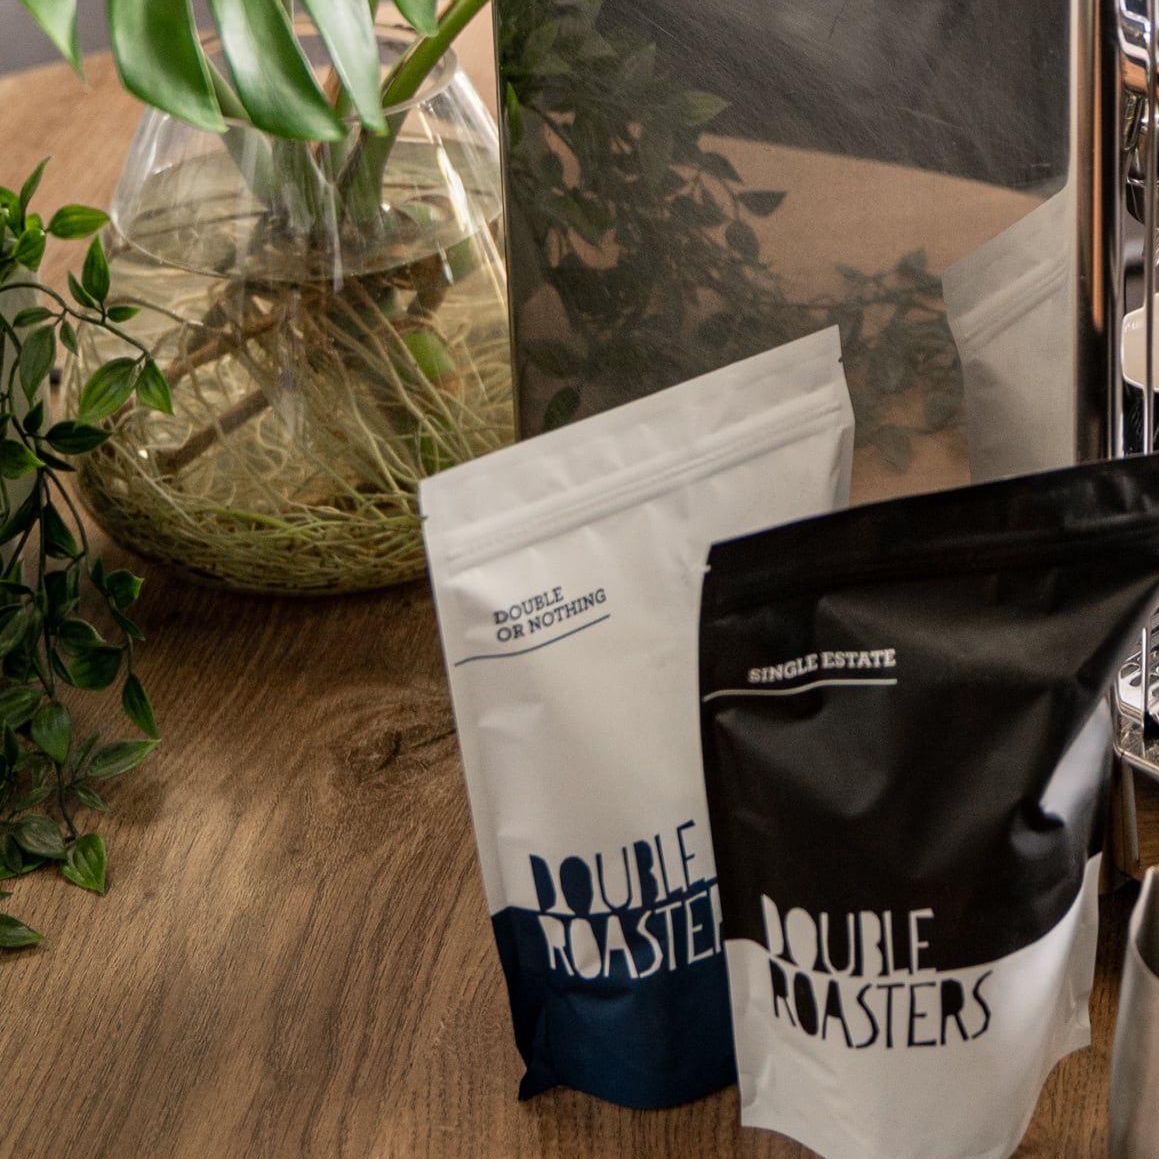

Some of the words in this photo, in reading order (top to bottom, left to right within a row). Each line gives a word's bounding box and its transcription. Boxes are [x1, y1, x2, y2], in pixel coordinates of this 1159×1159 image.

[493, 586, 564, 625] DOUBLE
[496, 624, 525, 642] OR
[528, 588, 607, 633] NOTHING
[748, 654, 818, 683] SINGLE
[821, 648, 897, 669] ESTATE
[529, 819, 706, 916] DOUBLE
[538, 884, 724, 980] ROASTE
[761, 893, 937, 978] DOUBLE
[769, 970, 993, 1049] ROASTERS
